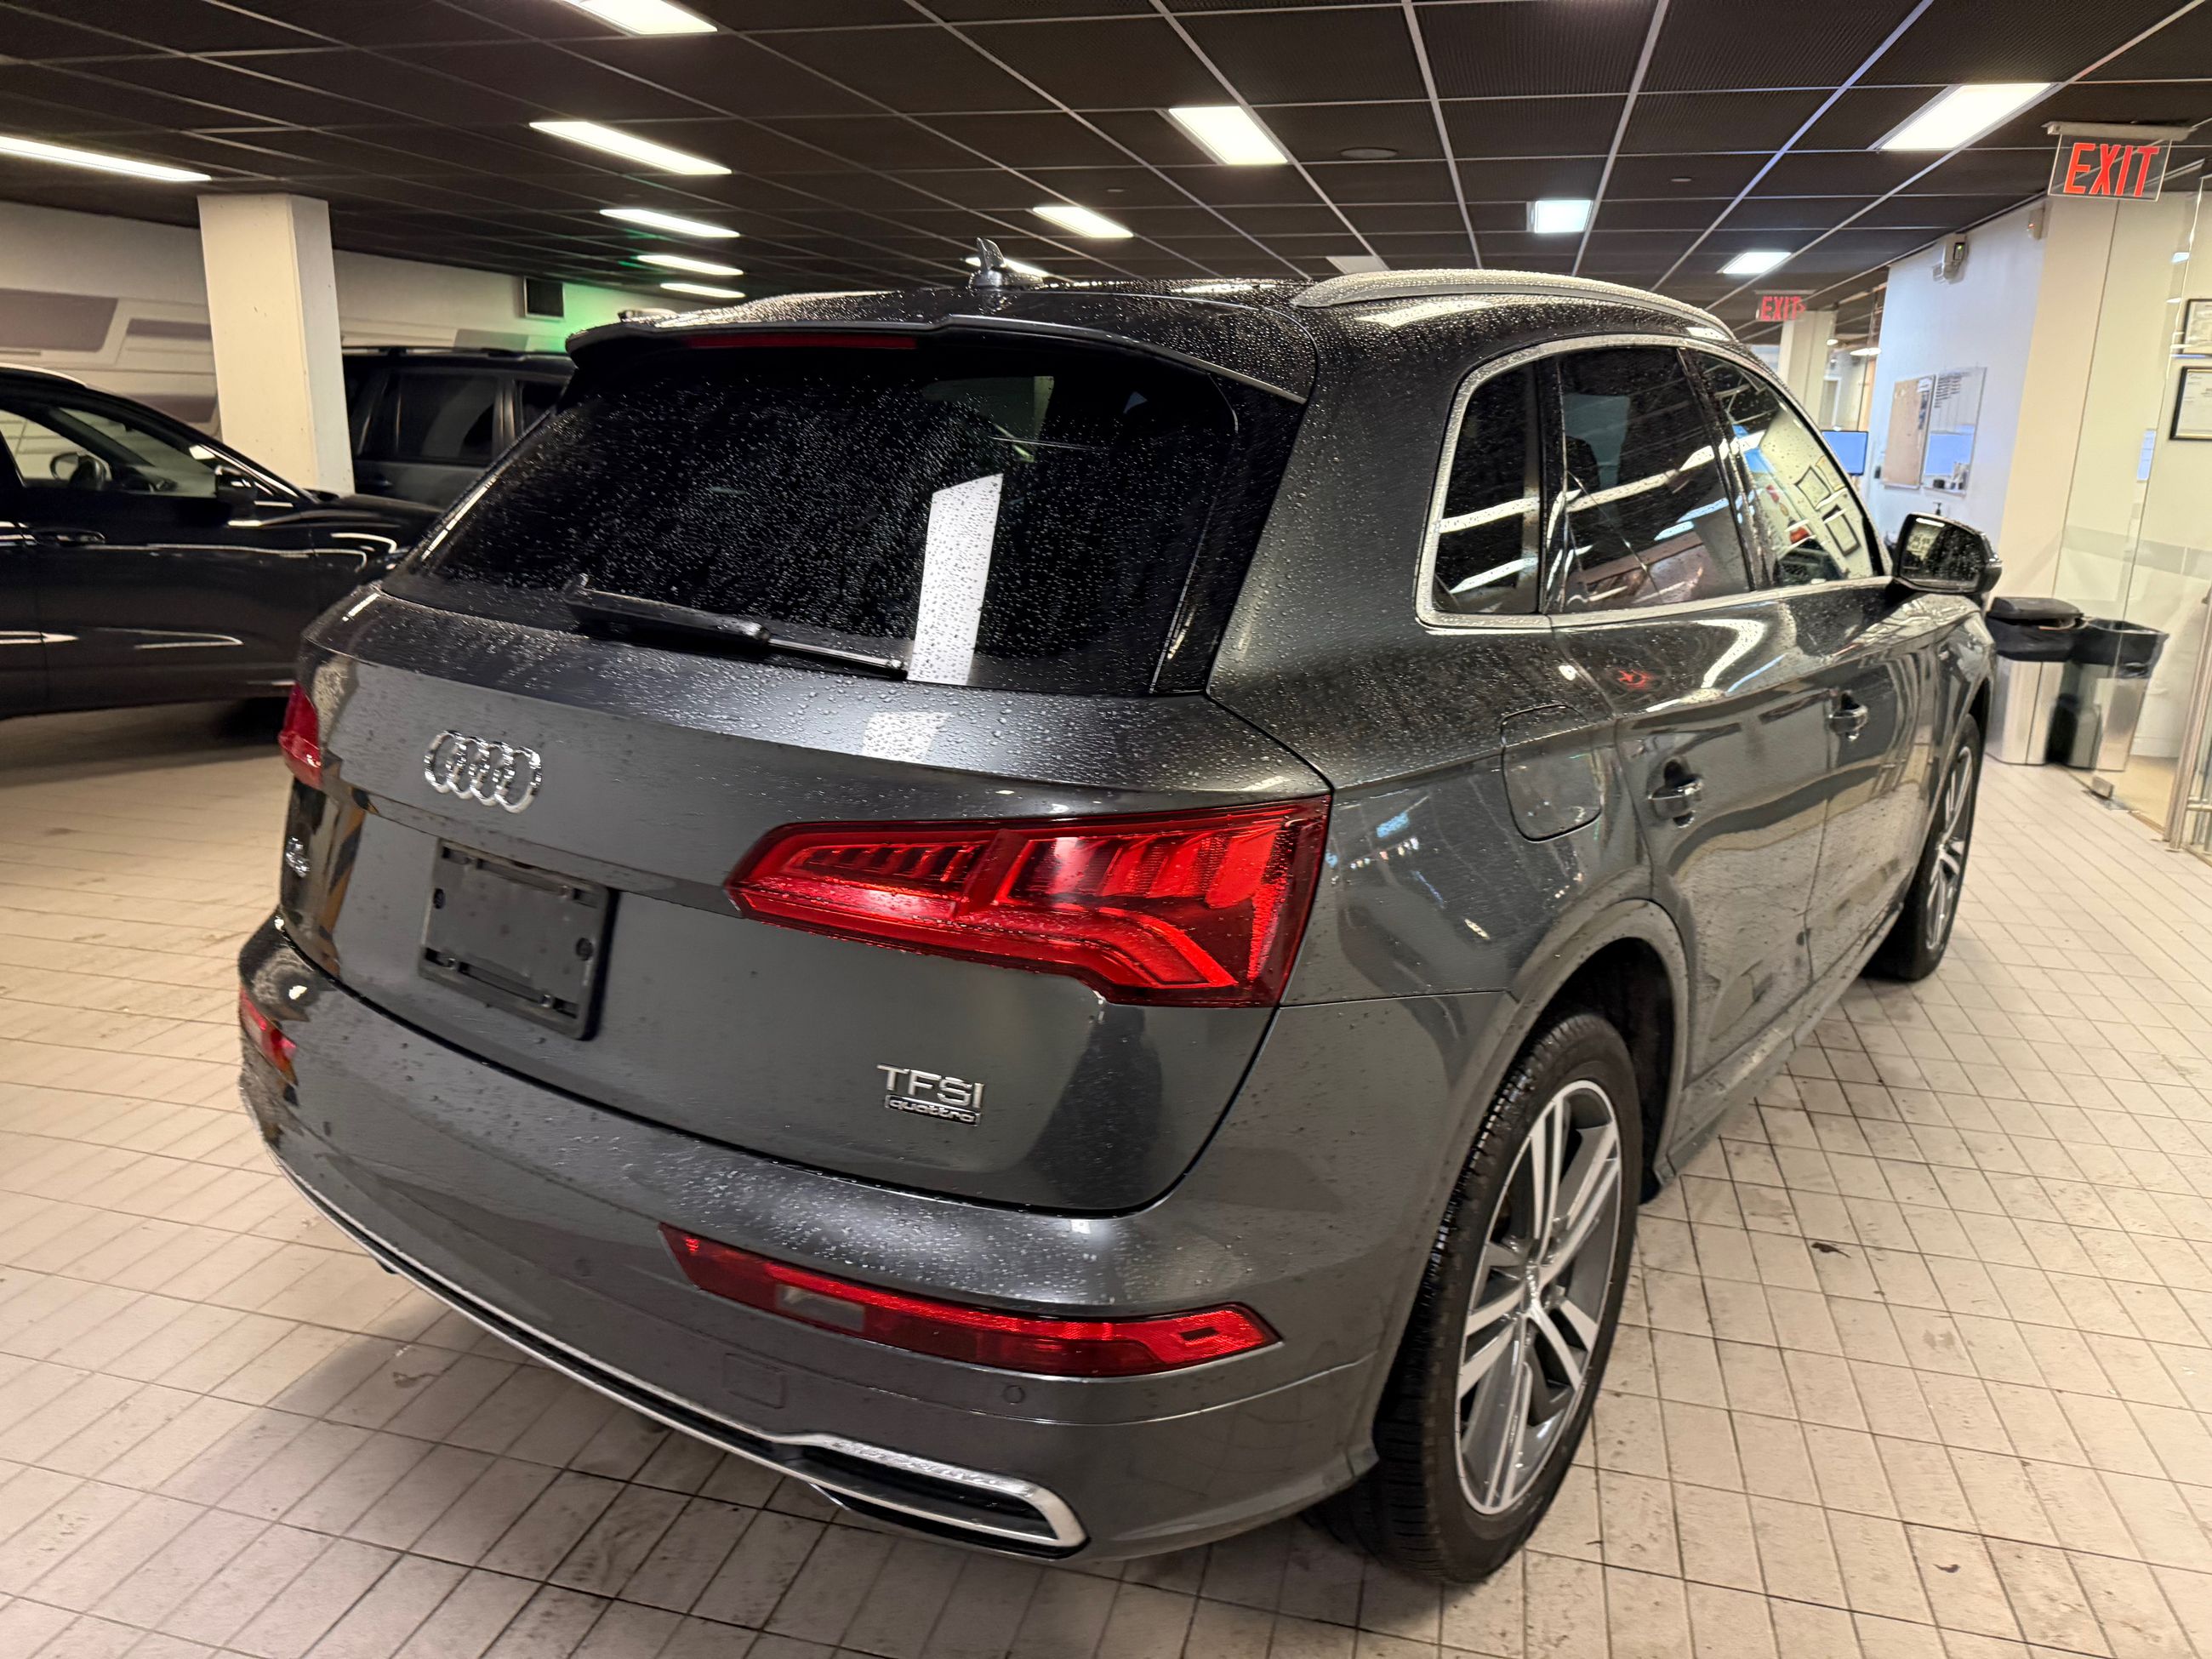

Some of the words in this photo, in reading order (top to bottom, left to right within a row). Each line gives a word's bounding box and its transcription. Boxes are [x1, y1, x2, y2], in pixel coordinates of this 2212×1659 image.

[2063, 142, 2160, 197] EXIT
[1760, 295, 1802, 321] EXIT
[876, 1063, 984, 1109] TFSI
[889, 1098, 976, 1123] quattro
